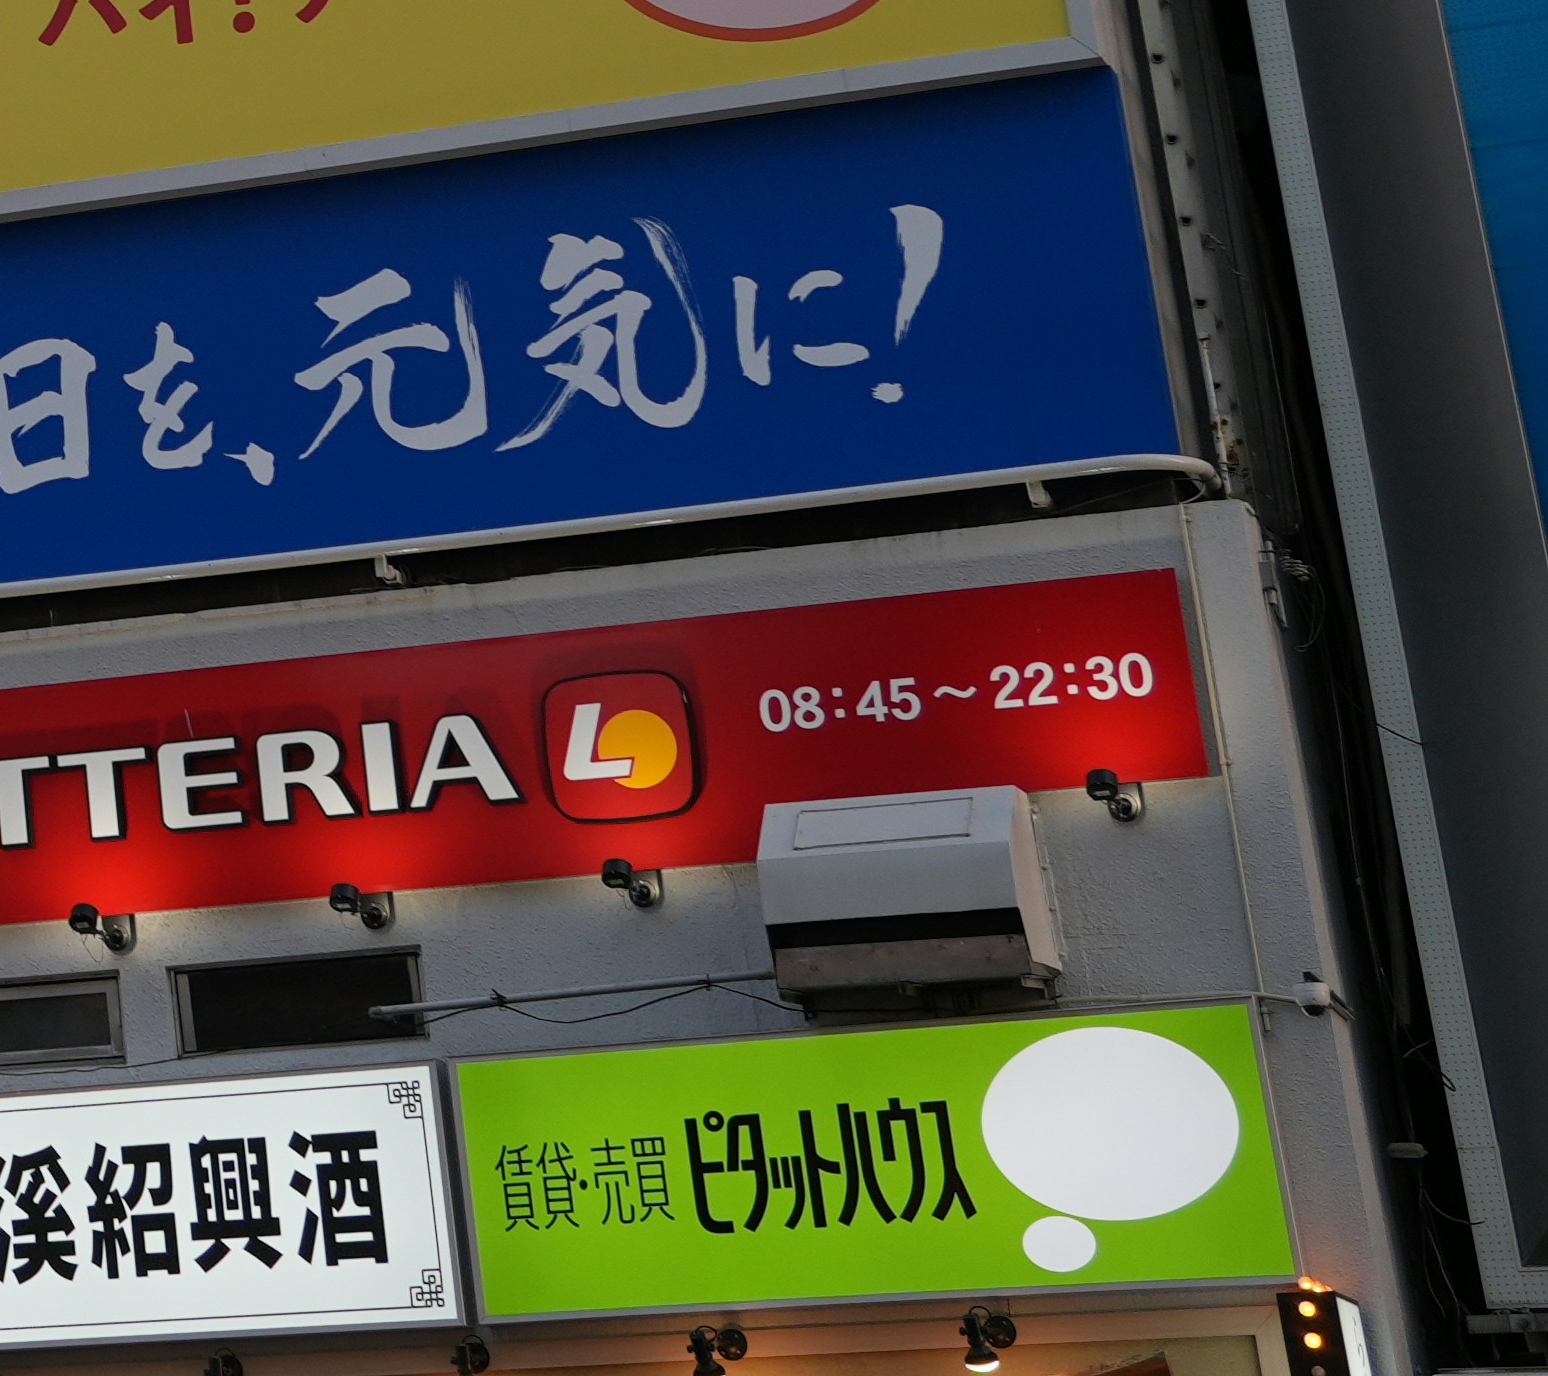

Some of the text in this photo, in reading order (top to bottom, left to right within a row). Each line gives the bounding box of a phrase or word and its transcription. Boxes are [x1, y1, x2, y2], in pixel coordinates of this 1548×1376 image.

[684, 1098, 979, 1235] ピタットハウス
